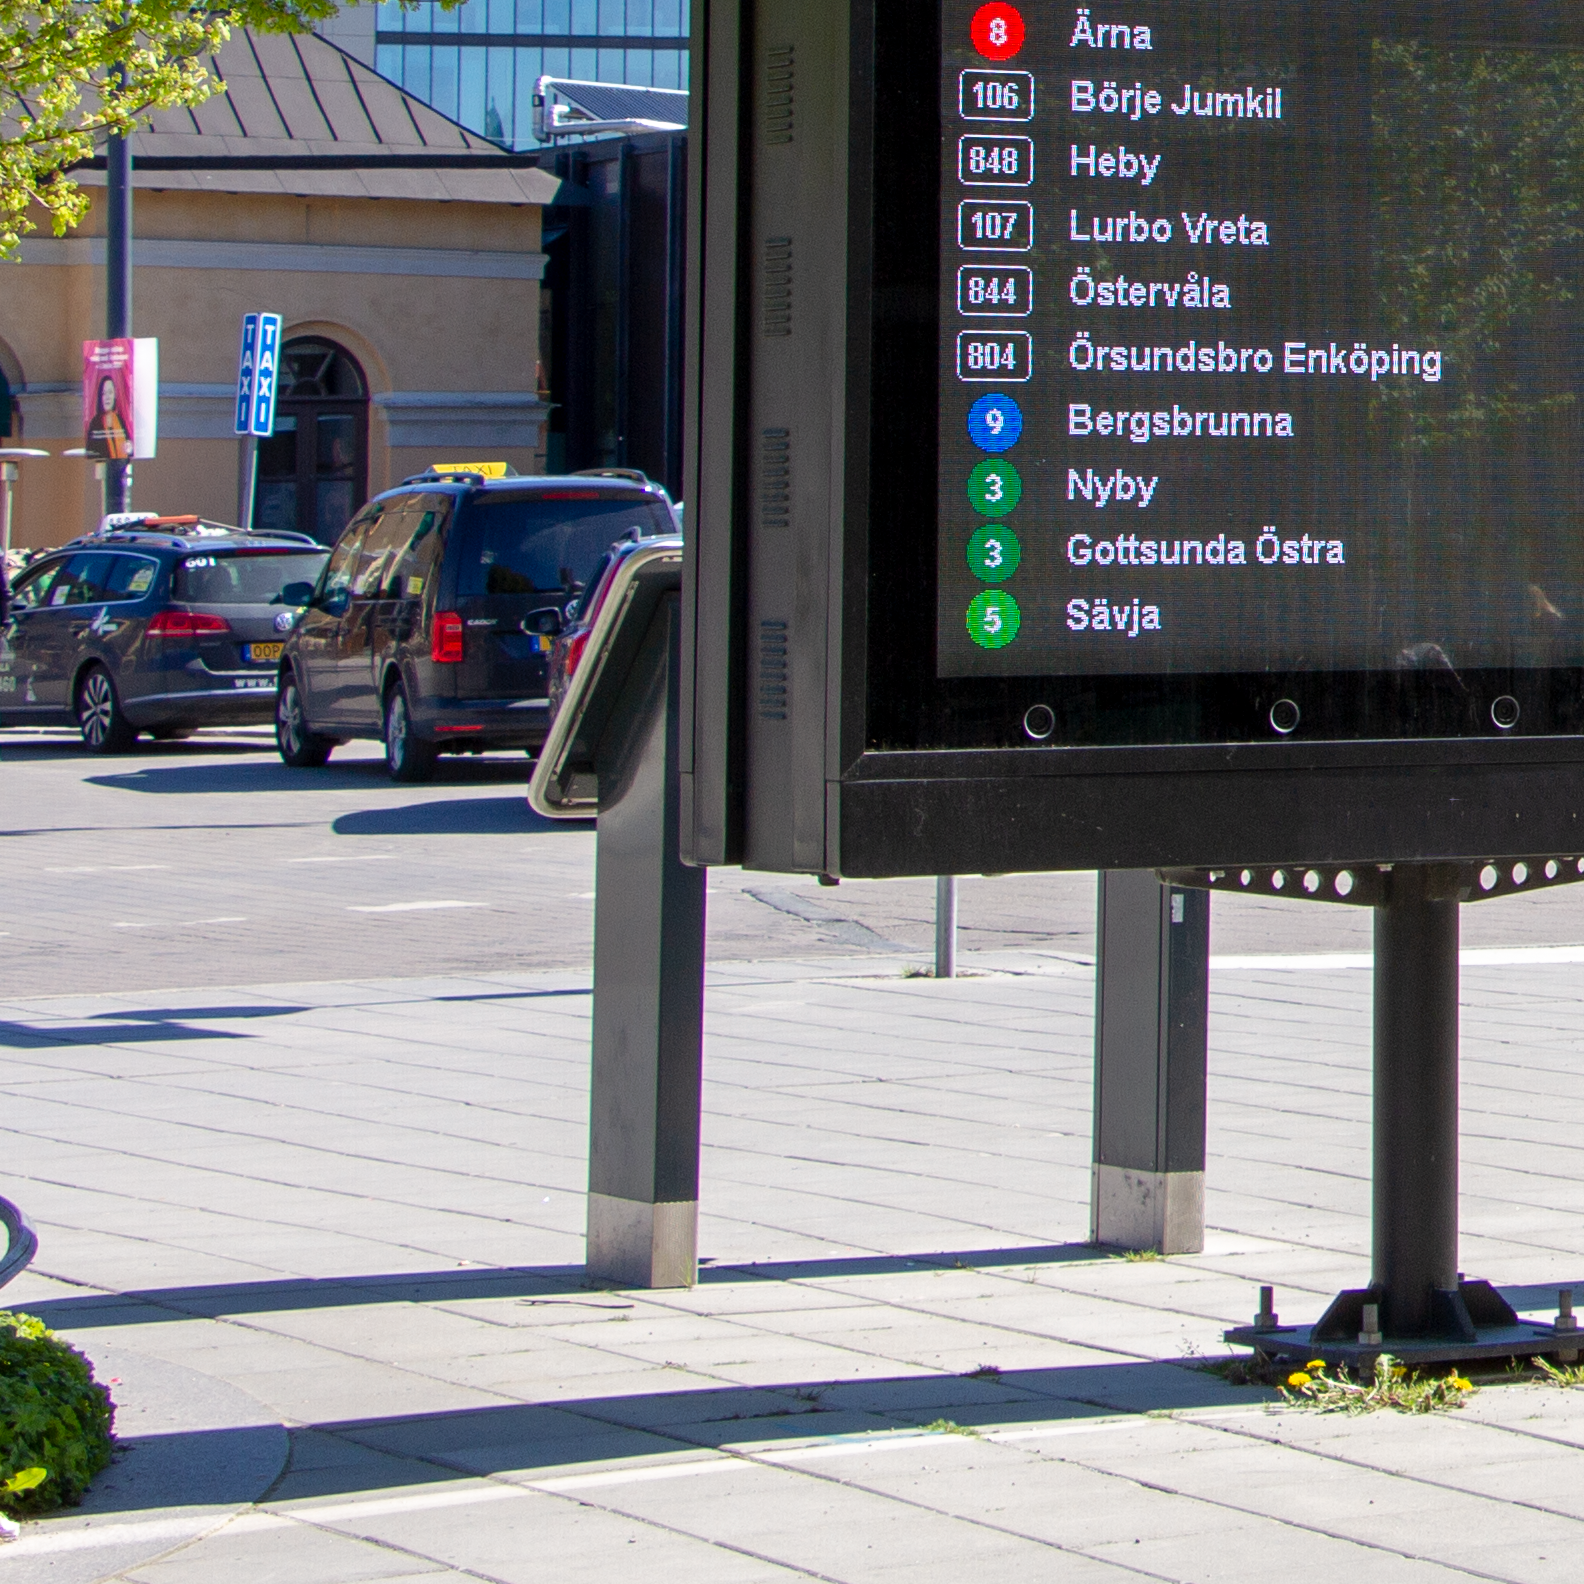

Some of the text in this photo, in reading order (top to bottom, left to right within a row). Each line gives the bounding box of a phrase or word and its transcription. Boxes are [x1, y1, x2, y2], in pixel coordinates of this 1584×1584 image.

[989, 18, 1007, 44] 8
[1069, 9, 1153, 49] Ärna
[972, 81, 1019, 110] 106
[1070, 79, 1162, 120] Börje
[1170, 84, 1283, 119] Jumkil
[969, 146, 1019, 174] 848
[1070, 144, 1161, 185] Heby
[971, 211, 1018, 240] 107
[1069, 209, 1171, 242] Lurbo
[1181, 211, 1270, 245] Vreta
[968, 277, 1017, 304] 844
[1069, 266, 1231, 308] Östervåla
[241, 324, 255, 421] TAXI
[259, 324, 276, 423] TAXI
[967, 342, 1016, 370] 804
[1068, 331, 1273, 372] Örsundsbro
[1283, 342, 1442, 382] Enköping
[985, 408, 1003, 434] 9
[1067, 403, 1294, 443] Bergsbrunna
[984, 474, 1003, 502] 3
[1066, 468, 1158, 508] Nyby
[984, 539, 1002, 568] 3
[1066, 533, 1246, 564] Gottsunda
[1256, 526, 1345, 564] Östra
[983, 606, 1002, 633] 5
[1066, 598, 1161, 637] Sävja
